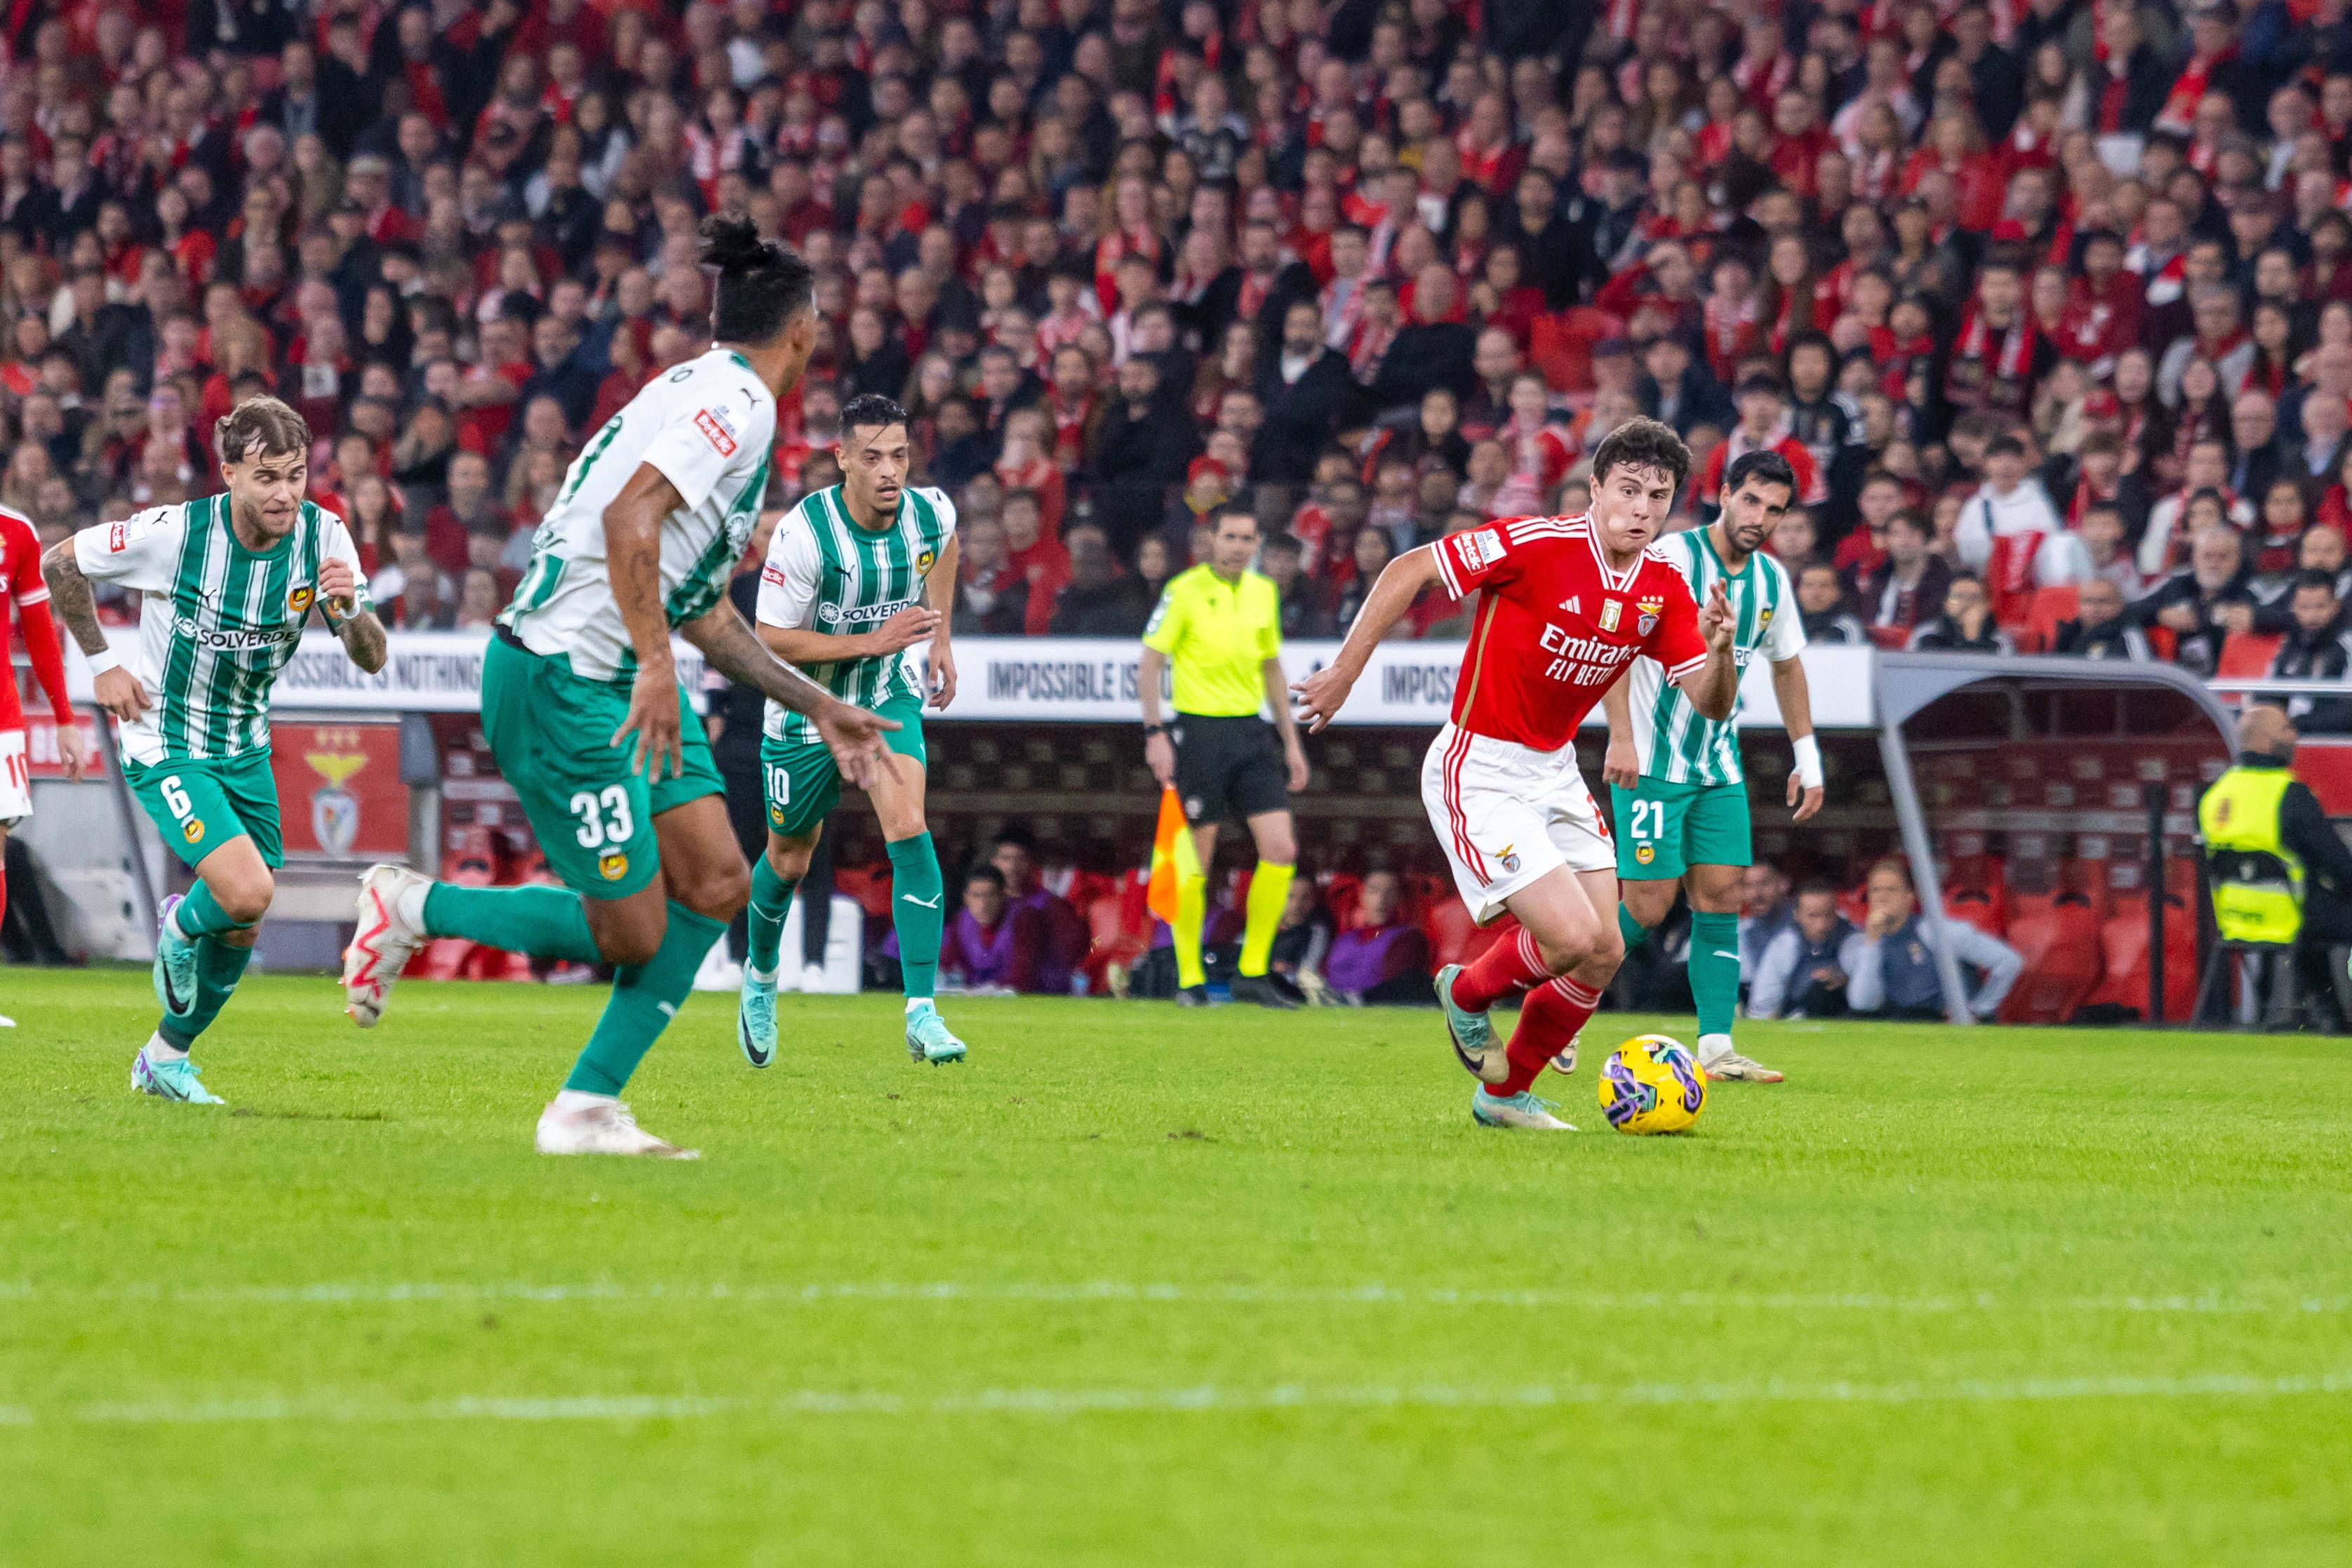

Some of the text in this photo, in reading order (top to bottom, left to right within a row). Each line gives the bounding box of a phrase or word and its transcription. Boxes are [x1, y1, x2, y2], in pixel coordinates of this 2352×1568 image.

[697, 413, 733, 453] Betclic
[1461, 533, 1482, 570] Betclic
[843, 600, 911, 621] SOLVERD
[198, 629, 296, 648] SOLVERDE
[987, 662, 1115, 700] IMPOSSIBLE
[1545, 658, 1577, 682] FLY
[160, 775, 192, 819] 6
[764, 762, 789, 805] 10
[570, 784, 634, 848] 33
[1631, 798, 1664, 839] 21
